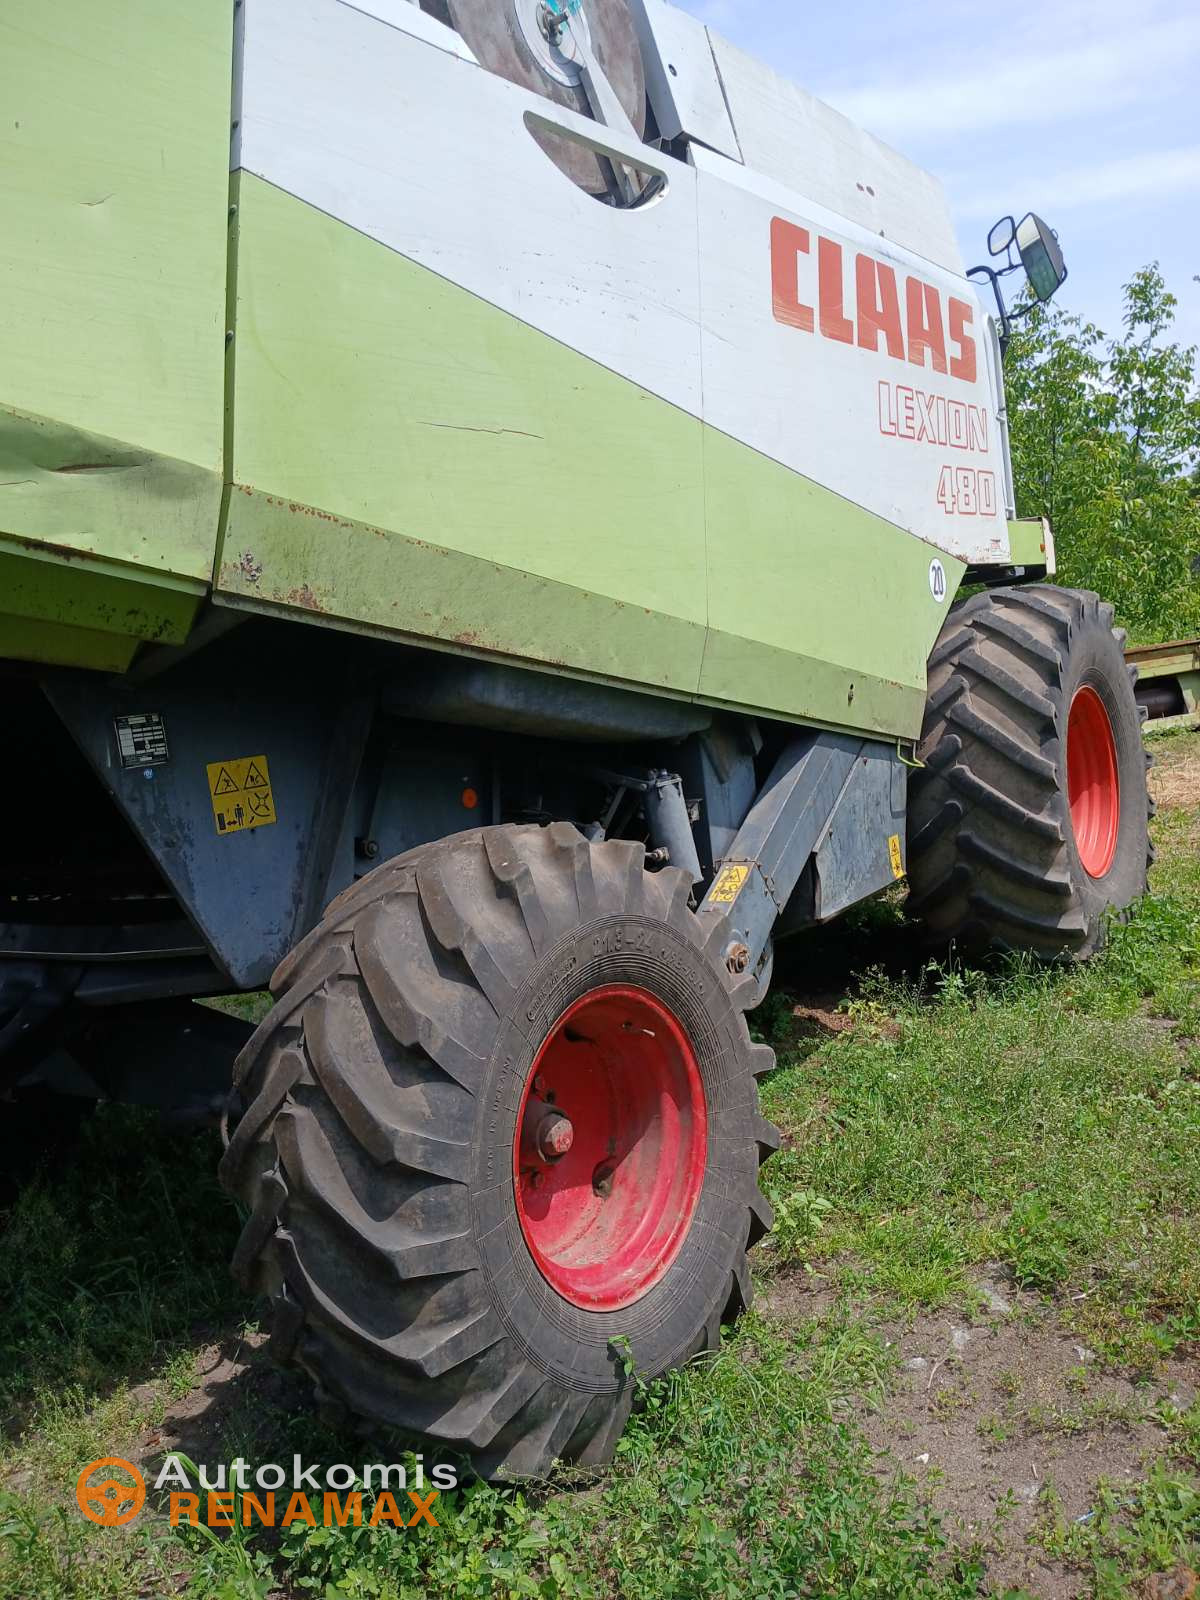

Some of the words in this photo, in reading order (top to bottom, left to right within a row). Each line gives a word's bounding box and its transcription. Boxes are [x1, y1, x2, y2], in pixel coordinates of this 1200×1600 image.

[770, 216, 977, 383] CLAAS
[878, 380, 989, 453] LEXION
[937, 465, 997, 516] 480
[932, 564, 944, 596] 20
